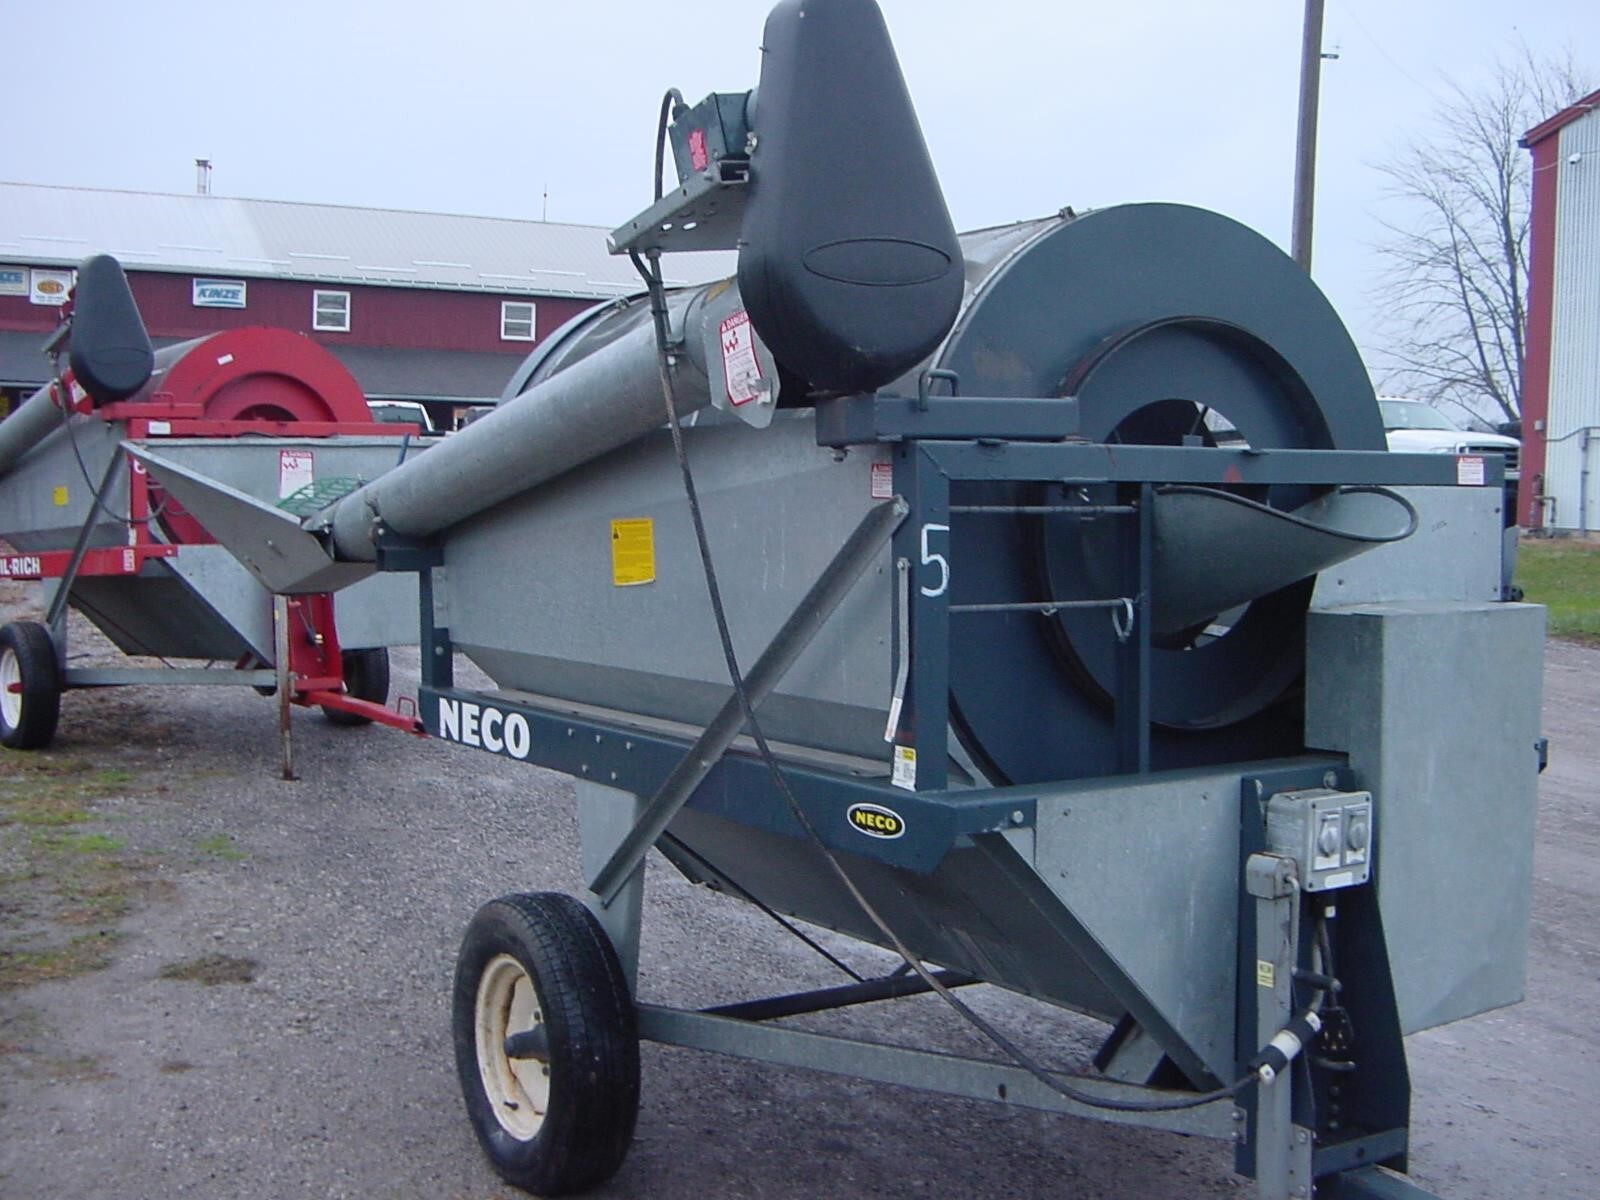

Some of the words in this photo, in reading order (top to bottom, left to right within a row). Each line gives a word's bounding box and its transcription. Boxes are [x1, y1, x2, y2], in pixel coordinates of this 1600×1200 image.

[198, 287, 242, 300] KINZE
[920, 523, 950, 597] 5
[439, 697, 530, 759] NECO
[855, 810, 897, 831] NECO
